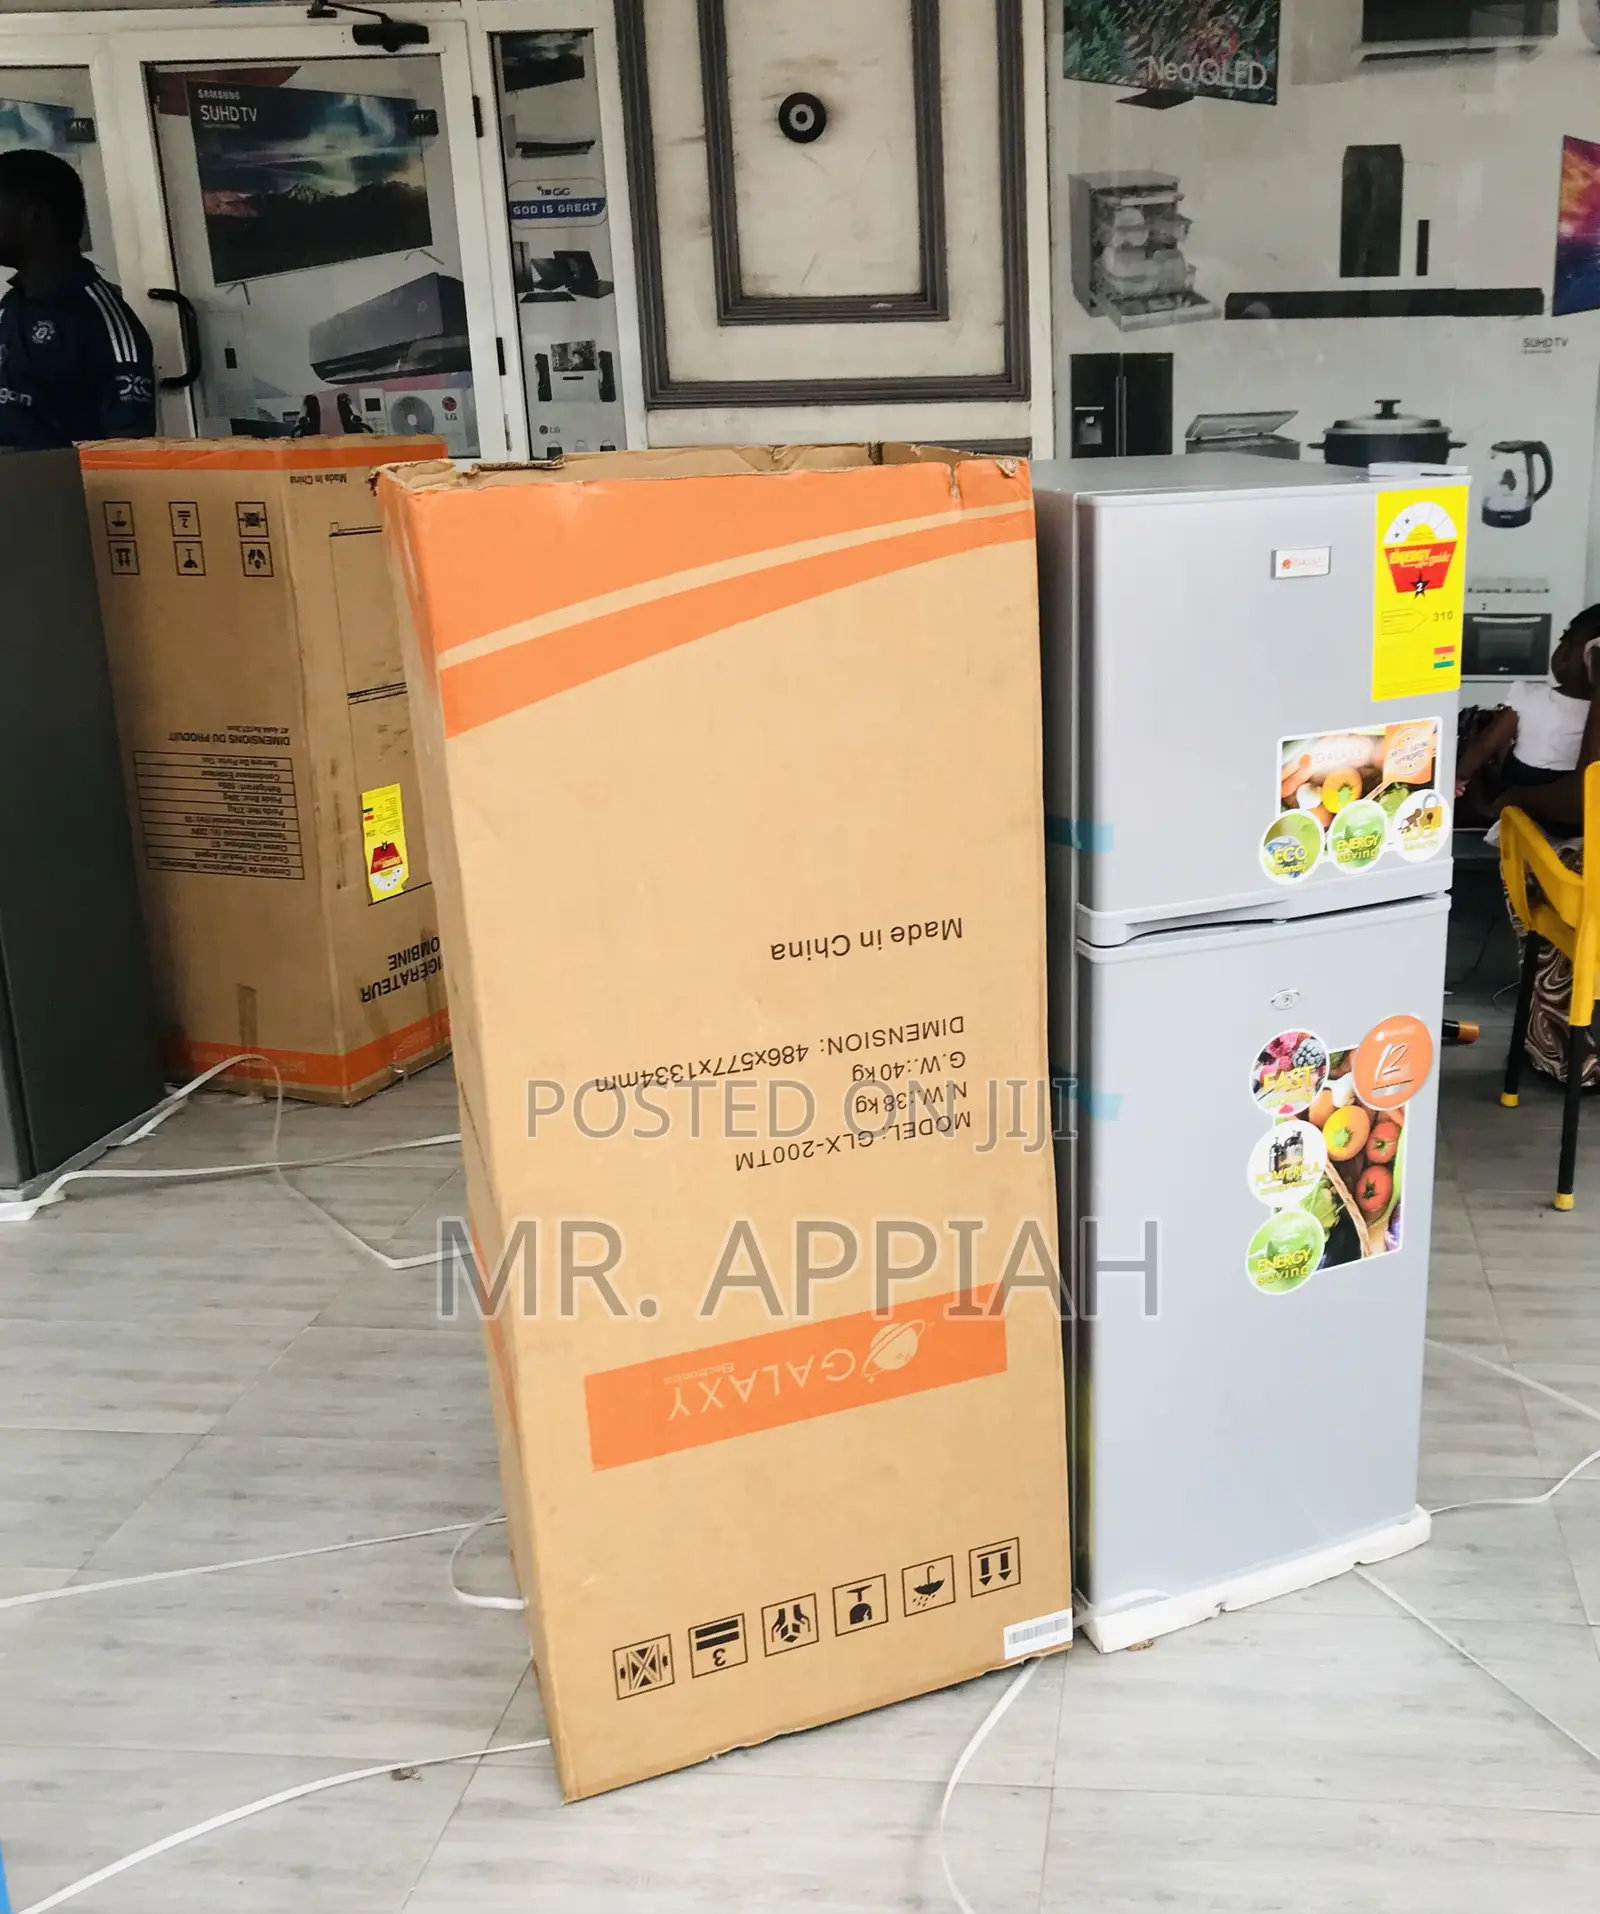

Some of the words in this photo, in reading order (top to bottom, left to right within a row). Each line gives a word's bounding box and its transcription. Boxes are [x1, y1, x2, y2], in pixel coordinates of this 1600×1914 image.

[1147, 55, 1193, 83] Neo
[1199, 59, 1268, 90] QLED
[197, 88, 241, 101] SAMSUNG
[199, 104, 239, 123] SUHD
[240, 106, 258, 122] TV
[513, 205, 538, 215] GOD
[542, 204, 554, 214] IS
[557, 202, 598, 213] GREAT
[0, 387, 32, 406] gon
[445, 412, 457, 422] LG
[1416, 582, 1424, 592] 2
[1433, 610, 1453, 622] 310
[228, 733, 290, 746] DIMENSIONS
[1273, 845, 1308, 863] ECO
[1335, 834, 1379, 853] ENERGY
[1335, 849, 1378, 864] saving
[860, 928, 882, 951] in
[890, 917, 963, 946] Made
[388, 936, 440, 971] OMBINE
[770, 934, 851, 961] China
[360, 956, 442, 1003] IGÉRATEUR
[820, 1015, 965, 1055] DIMENSION:
[594, 1043, 809, 1094] 486x577x1334mm
[1263, 1065, 1314, 1094] FAST
[880, 1111, 972, 1141] MODEL:
[735, 1129, 875, 1171] GLX-200TM
[1256, 1247, 1312, 1273] ENERGY
[1256, 1264, 1309, 1286] saving
[663, 1361, 735, 1386] Electronics
[668, 1348, 857, 1422] GALAXY
[712, 1647, 727, 1668] 3
